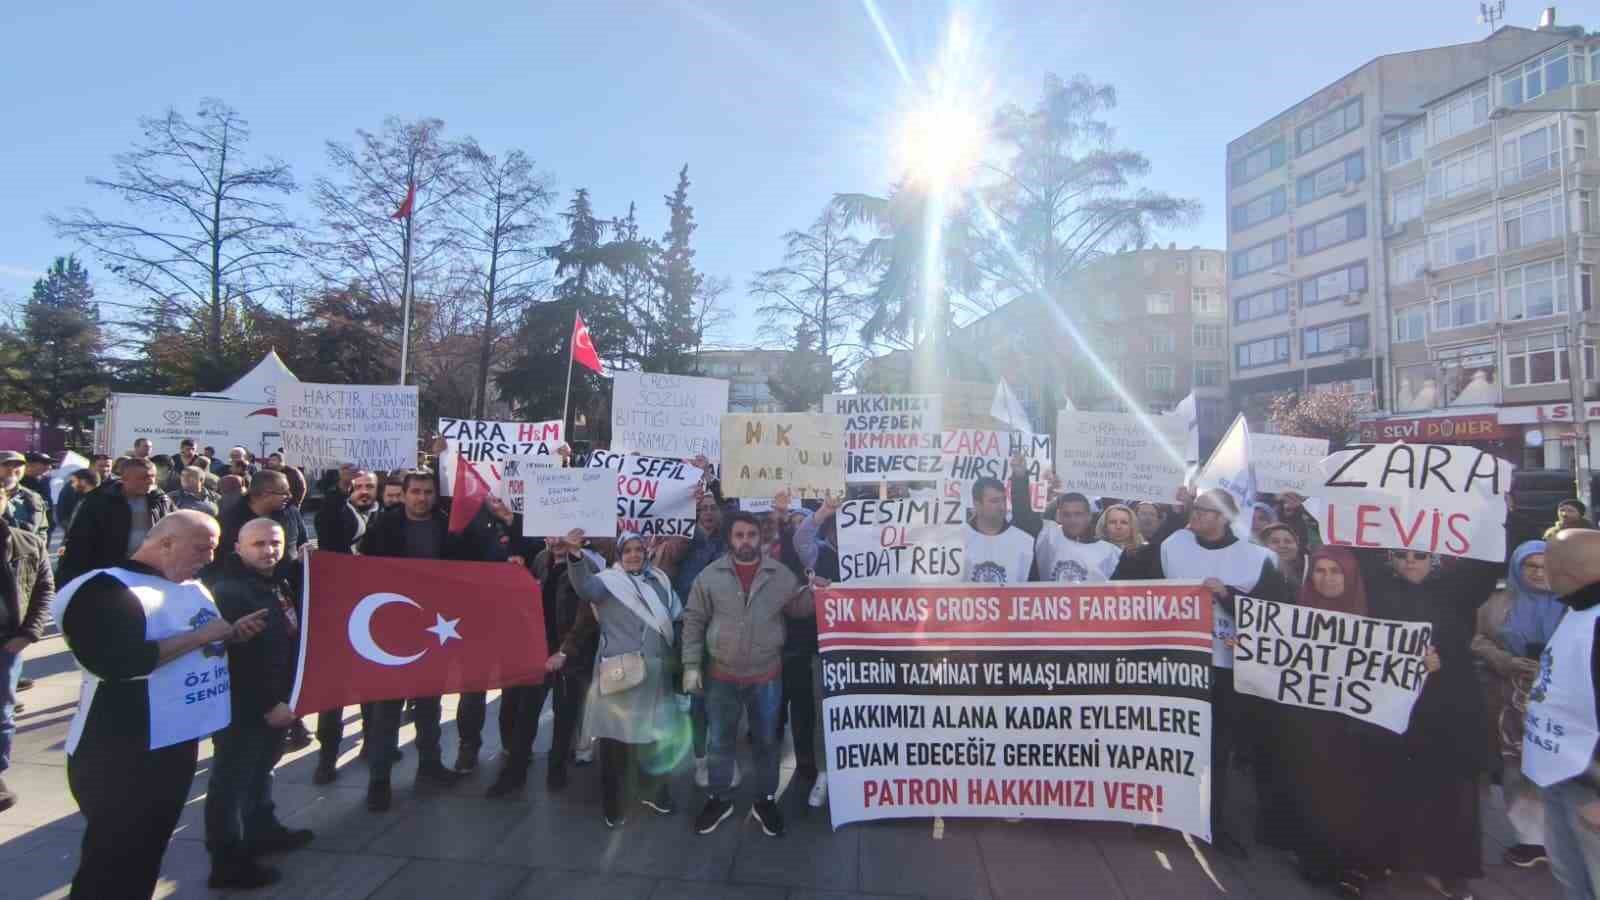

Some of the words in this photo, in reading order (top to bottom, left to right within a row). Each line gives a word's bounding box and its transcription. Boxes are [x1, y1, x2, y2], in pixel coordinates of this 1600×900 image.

[441, 418, 506, 442] ZARA
[518, 423, 560, 442] H&M
[943, 430, 1001, 456] ZARA
[951, 456, 1041, 482] HIRSIA
[1324, 444, 1500, 495] ZARA
[641, 518, 697, 537] ARSIZ
[840, 498, 963, 529] SESİMİZ
[1327, 504, 1471, 555] LEVİS
[881, 525, 914, 547] OL
[841, 545, 907, 582] SEDAT
[911, 545, 962, 576] REİS
[825, 598, 855, 628] ŞIK
[862, 597, 929, 622] MAKAS
[936, 597, 1000, 621] CROSS
[1008, 596, 1071, 621] JEANS
[1079, 590, 1201, 621] FARBRİKASI
[1238, 597, 1284, 635] BİR
[184, 671, 209, 687] ÖZ
[823, 657, 896, 691] İŞÇİLERİN
[900, 657, 978, 685] TAZMİNAT
[983, 662, 1003, 685] VE
[1009, 662, 1110, 691] MAAŞLARINI
[1115, 656, 1209, 690] ÖDEMİYOR!
[1235, 634, 1337, 673] SEDAT
[1349, 649, 1427, 692] PEKER
[1278, 669, 1373, 715] REİS
[830, 705, 925, 733] HAKKIMIZI
[932, 706, 998, 730] ALANA
[1005, 706, 1072, 730] KADAR
[1081, 706, 1201, 737] EYLEMLERE
[836, 743, 899, 770] DEVAM
[906, 736, 996, 767] EDECEĞİZ
[1003, 738, 1100, 768] GEREKENİ
[1107, 743, 1195, 776] YAPARIZ
[864, 779, 958, 808] PATRON
[967, 779, 1095, 808] HAKKIMIZI
[1104, 781, 1164, 812] VER!
